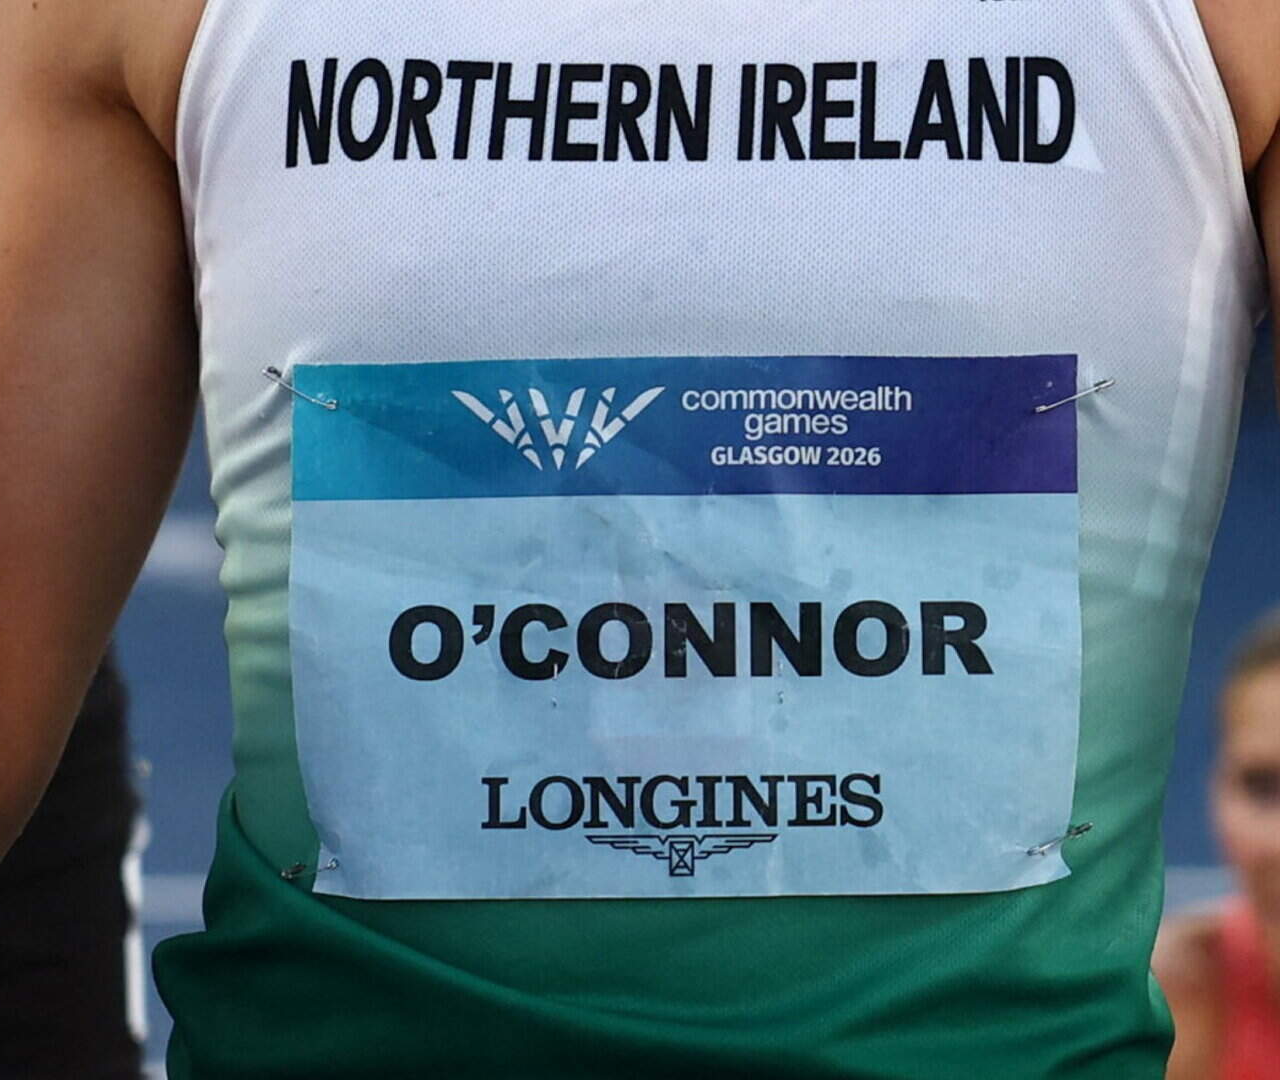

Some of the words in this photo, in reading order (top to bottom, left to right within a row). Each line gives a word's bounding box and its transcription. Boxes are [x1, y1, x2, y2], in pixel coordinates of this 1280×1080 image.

[285, 57, 713, 169] NORTHERN
[737, 56, 1076, 164] IRELAND
[681, 385, 913, 412] commonwealth
[743, 412, 849, 441] games
[710, 445, 822, 466] GLASGOW
[826, 446, 882, 467] 2026
[388, 601, 994, 682] O’CONNOR
[481, 773, 884, 831] LONGINES
